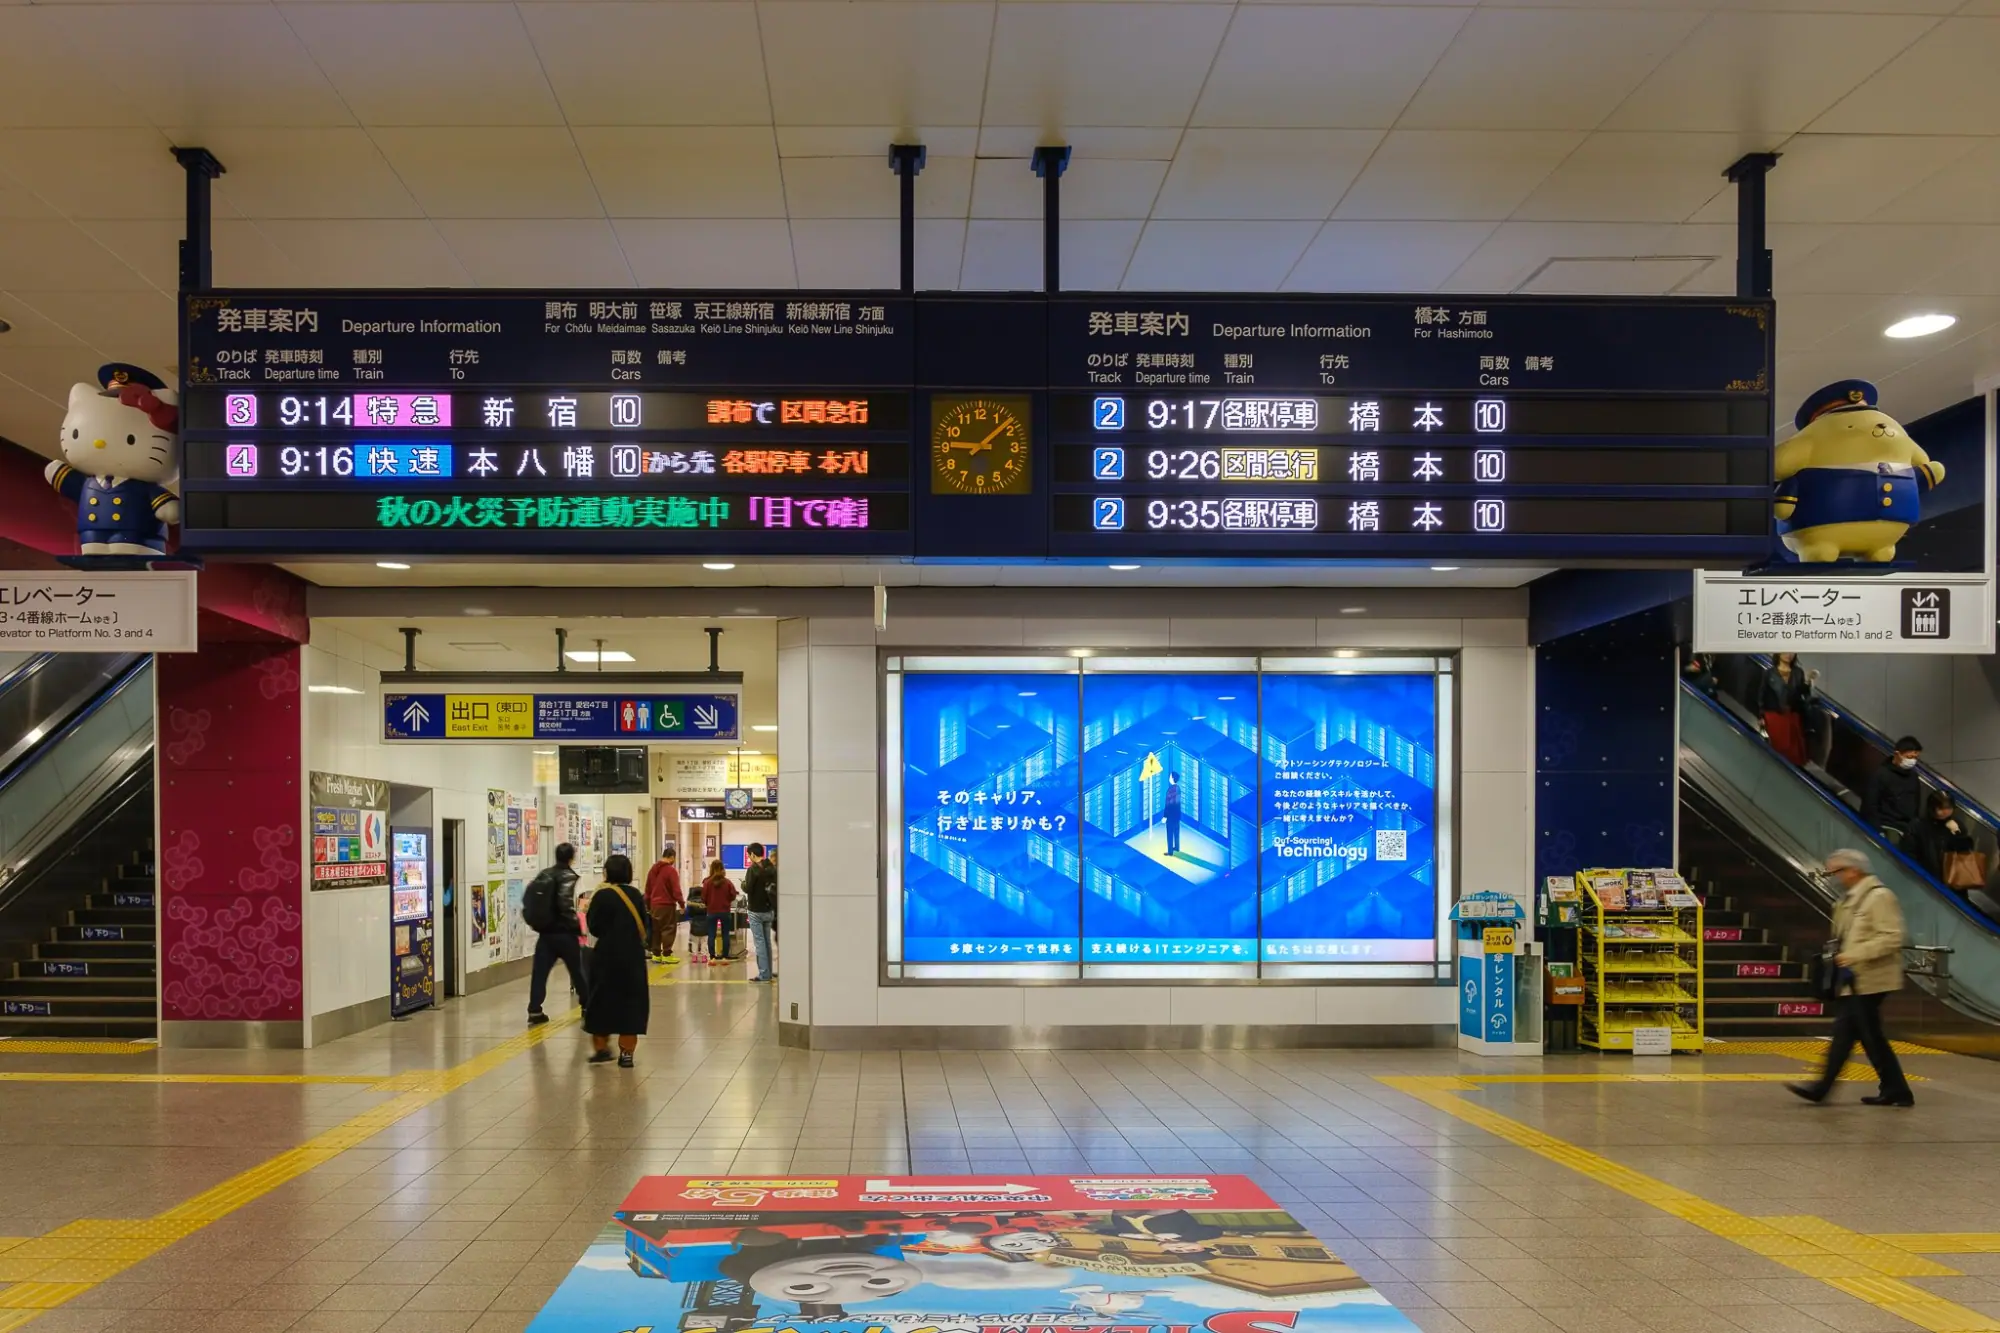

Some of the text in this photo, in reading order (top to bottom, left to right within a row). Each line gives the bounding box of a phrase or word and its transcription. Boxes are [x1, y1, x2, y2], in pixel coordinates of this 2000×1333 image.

[545, 302, 884, 321] 調布 明大前 笹塚 京王線新宿 新線新宿 方面
[1415, 307, 1487, 325] 橋本 方面
[217, 308, 318, 332] 発車案内
[1088, 312, 1189, 336] 発車案内
[342, 320, 501, 335] Departure Information
[545, 323, 560, 333] For
[597, 323, 646, 333] Meidaimae
[652, 323, 696, 333] Sasazuka
[724, 323, 742, 333] Line
[745, 324, 783, 336] Shinjuku
[811, 324, 831, 334] New
[834, 324, 852, 334] Line
[855, 324, 894, 336] Shinjuku
[1213, 323, 1371, 339] Departure Information
[1414, 328, 1493, 339] For Hashimoto
[216, 349, 686, 365] のりば 発車時刻 種別 行先 両数 備考
[1087, 353, 1554, 370] のりば 発車時刻 種別 行先 両数 備考
[218, 368, 641, 381] Track Departure time Train To Cars
[1089, 372, 1509, 386] Track Departure time Train To Cars
[232, 398, 251, 424] 3
[280, 397, 353, 425] 9:14
[367, 396, 440, 426] 特急
[614, 399, 637, 424] 10
[781, 400, 869, 424] 区間急行
[974, 409, 987, 420] 12
[993, 412, 999, 424] 1
[1100, 402, 1119, 426] 2
[1148, 400, 1221, 429] 9:17
[1224, 400, 1316, 428] 各駅停車
[1478, 404, 1501, 428] 10
[958, 413, 970, 424] 11
[946, 427, 960, 437] 10
[1006, 425, 1014, 436] 2
[941, 441, 950, 453] 9
[1010, 442, 1019, 453] 3
[232, 448, 253, 473] 4
[280, 447, 353, 475] 9:16
[368, 446, 441, 476] 快速
[614, 449, 637, 474] 10
[721, 450, 812, 474] 各駅停車
[818, 450, 869, 474] 本八
[947, 458, 955, 469] 8
[1005, 460, 1014, 469] 4
[1100, 452, 1119, 476] 2
[1148, 450, 1221, 479] 9:26
[1223, 450, 1316, 478] 区間急行
[1478, 454, 1501, 478] 10
[960, 470, 968, 481] 7
[976, 475, 985, 486] 6
[993, 471, 1001, 482] 5
[376, 497, 730, 528] 秋の火災予防運動実施中
[1100, 501, 1119, 526] 2
[1148, 500, 1221, 530] 9:35
[1224, 501, 1316, 528] 各駅停車
[1478, 504, 1501, 528] 10
[1739, 588, 1862, 607] エレベーター
[35, 630, 46, 638] to
[49, 629, 91, 638] Platform
[95, 629, 111, 638] No.
[114, 629, 121, 638] 3
[125, 629, 143, 638] and
[145, 629, 153, 638] 4
[1737, 630, 1777, 639] Elevator
[1781, 631, 1791, 639] to
[1795, 630, 1837, 640] Platform
[1865, 630, 1882, 640] and
[1885, 631, 1893, 640] 2
[452, 701, 489, 720] 出口
[1274, 759, 1389, 768] アウトソーシングテクノロジーに
[1274, 772, 1333, 780] ご相談ください。
[326, 776, 363, 796] Fresh Market
[937, 790, 1042, 805] そのキャリア、
[937, 815, 1066, 832] 行き止まりかも？
[1275, 844, 1367, 861] Technology
[950, 943, 1073, 954] 多摩センターで世界を
